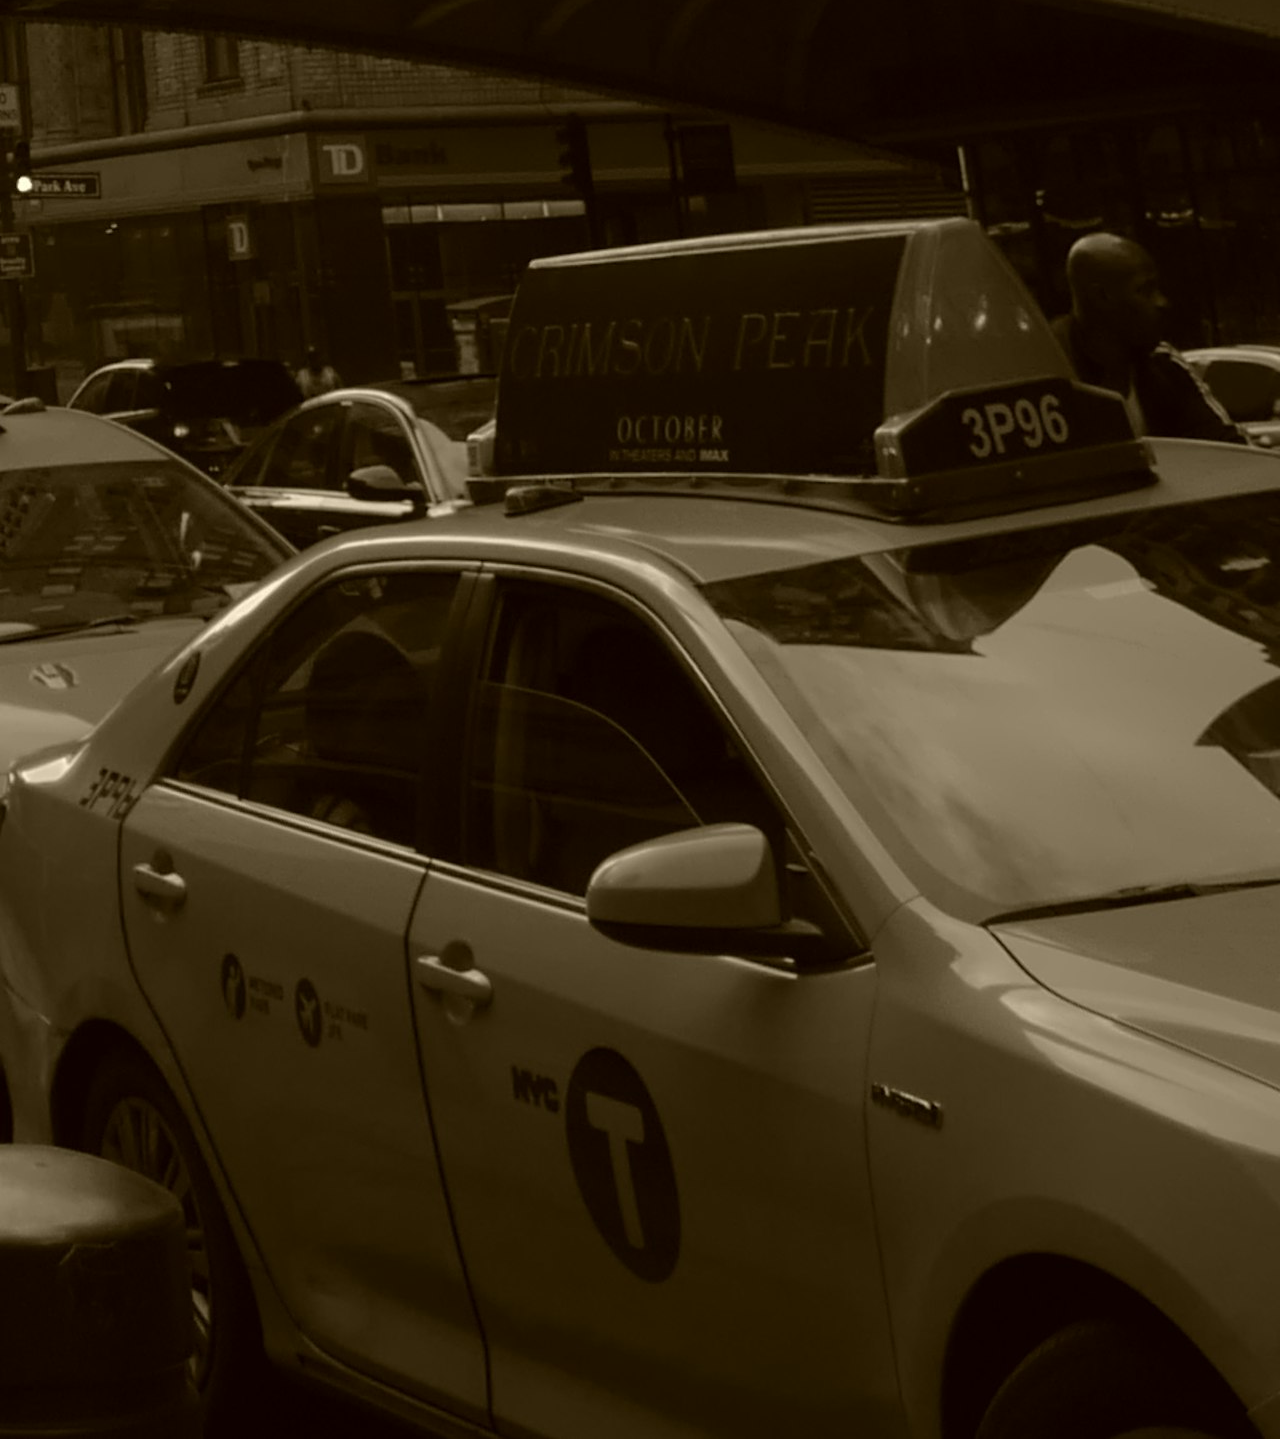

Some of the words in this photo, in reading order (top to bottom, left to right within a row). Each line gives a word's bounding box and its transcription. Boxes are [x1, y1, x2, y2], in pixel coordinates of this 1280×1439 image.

[322, 143, 364, 176] TD
[375, 140, 448, 166] Bank
[64, 179, 87, 193] Ave
[508, 315, 712, 379] CRIMSON
[733, 305, 875, 371] PEAK
[616, 414, 724, 444] OCTOBER
[961, 394, 1070, 459] 3P96
[698, 448, 730, 462] IMAX
[511, 1064, 561, 1114] NYC
